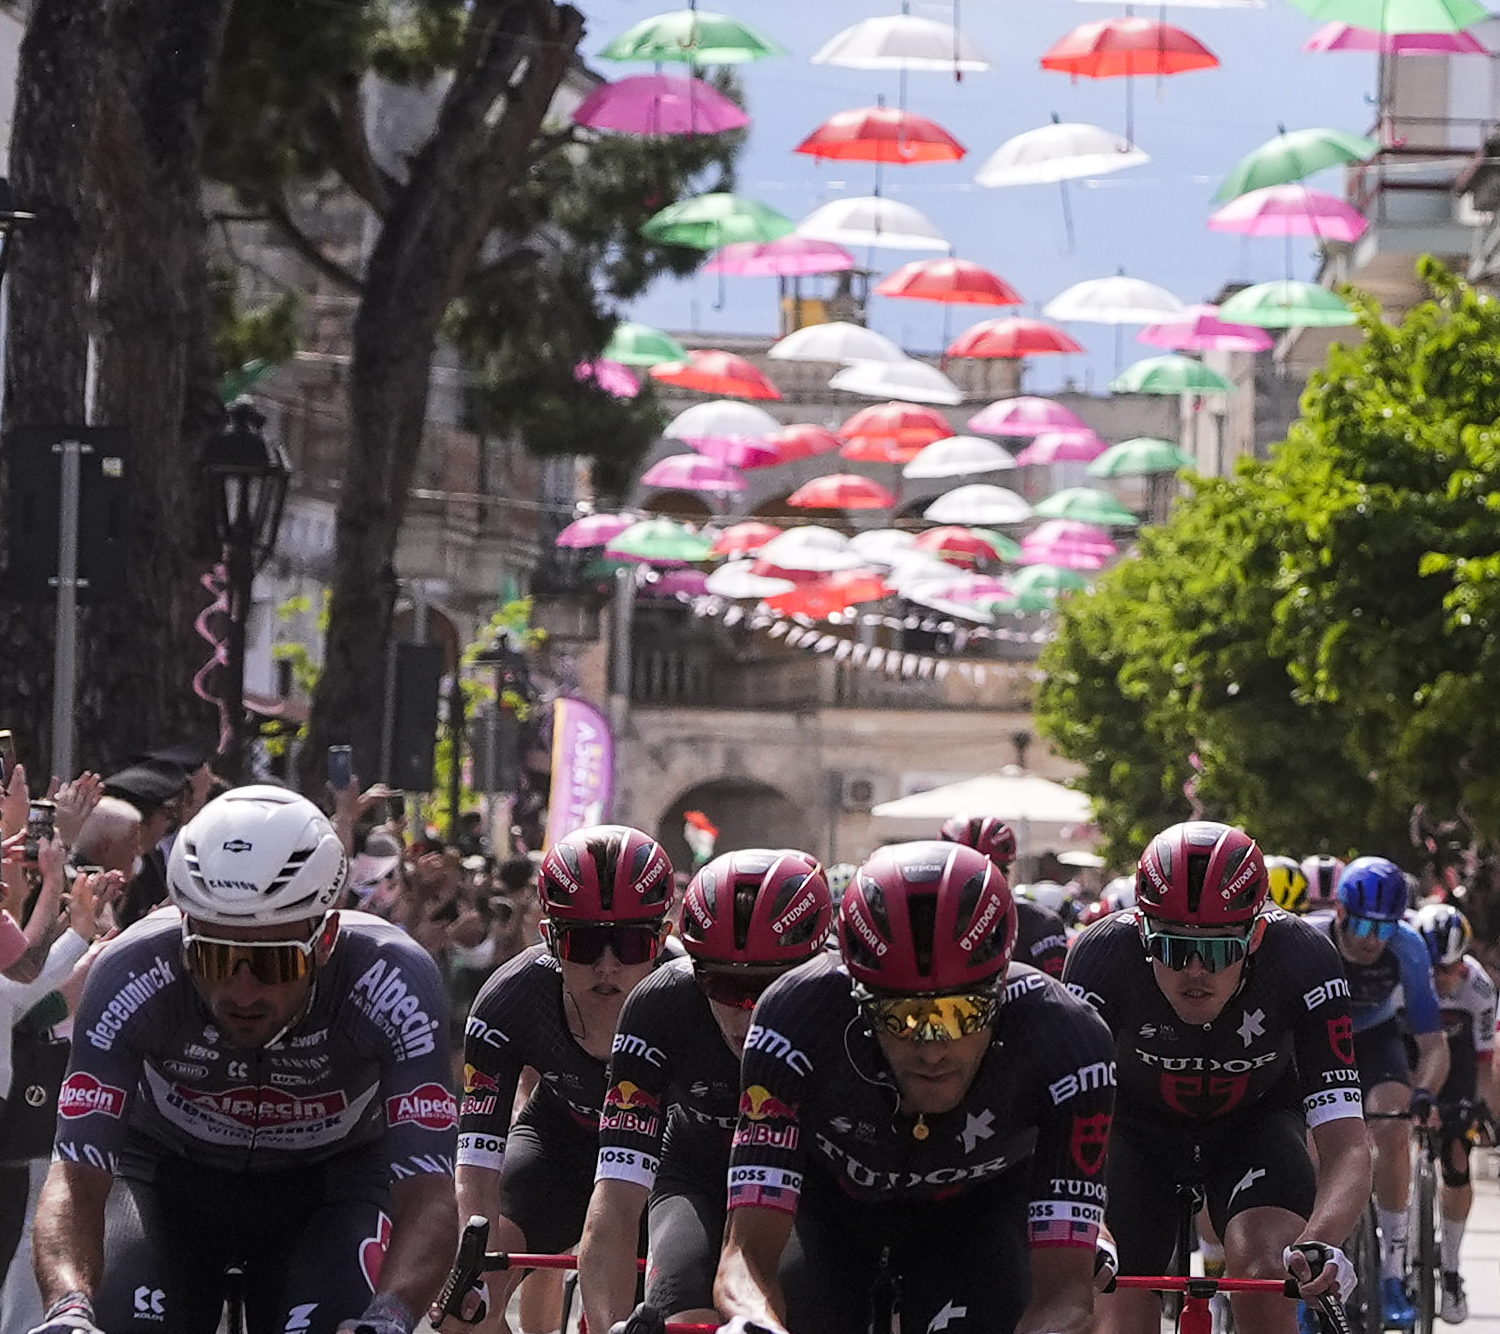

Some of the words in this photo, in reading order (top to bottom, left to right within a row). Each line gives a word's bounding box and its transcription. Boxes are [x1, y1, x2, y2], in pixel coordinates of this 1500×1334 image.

[208, 879, 259, 893] CANYON
[546, 857, 572, 889] TUDOR
[1144, 853, 1164, 889] TUDOR
[1229, 864, 1256, 894] TUDOR
[689, 886, 706, 922] TUDOR
[781, 894, 813, 926] TUDOR
[969, 895, 999, 941] TUDOR
[1255, 909, 1288, 924] MC
[850, 901, 879, 948] TUDOR
[86, 956, 175, 1051] deceuninck
[355, 958, 439, 1059] Alpecin
[1066, 982, 1106, 1012] MC
[290, 1028, 331, 1049] ZWIFT
[743, 1023, 814, 1077] BMC
[1135, 1049, 1279, 1074] TUDOR
[60, 1084, 114, 1108] lpecin
[1048, 1060, 1118, 1106] BMC
[1343, 1091, 1362, 1104] BO
[191, 1095, 328, 1120] Alpecin
[601, 1111, 622, 1130] ed
[622, 1113, 659, 1138] Bull
[732, 1127, 750, 1148] ed
[752, 1123, 799, 1151] Bull
[641, 1155, 660, 1174] BO
[815, 1132, 1008, 1188] TUDOR
[731, 1169, 767, 1184] BOSS
[780, 1173, 801, 1190] BO
